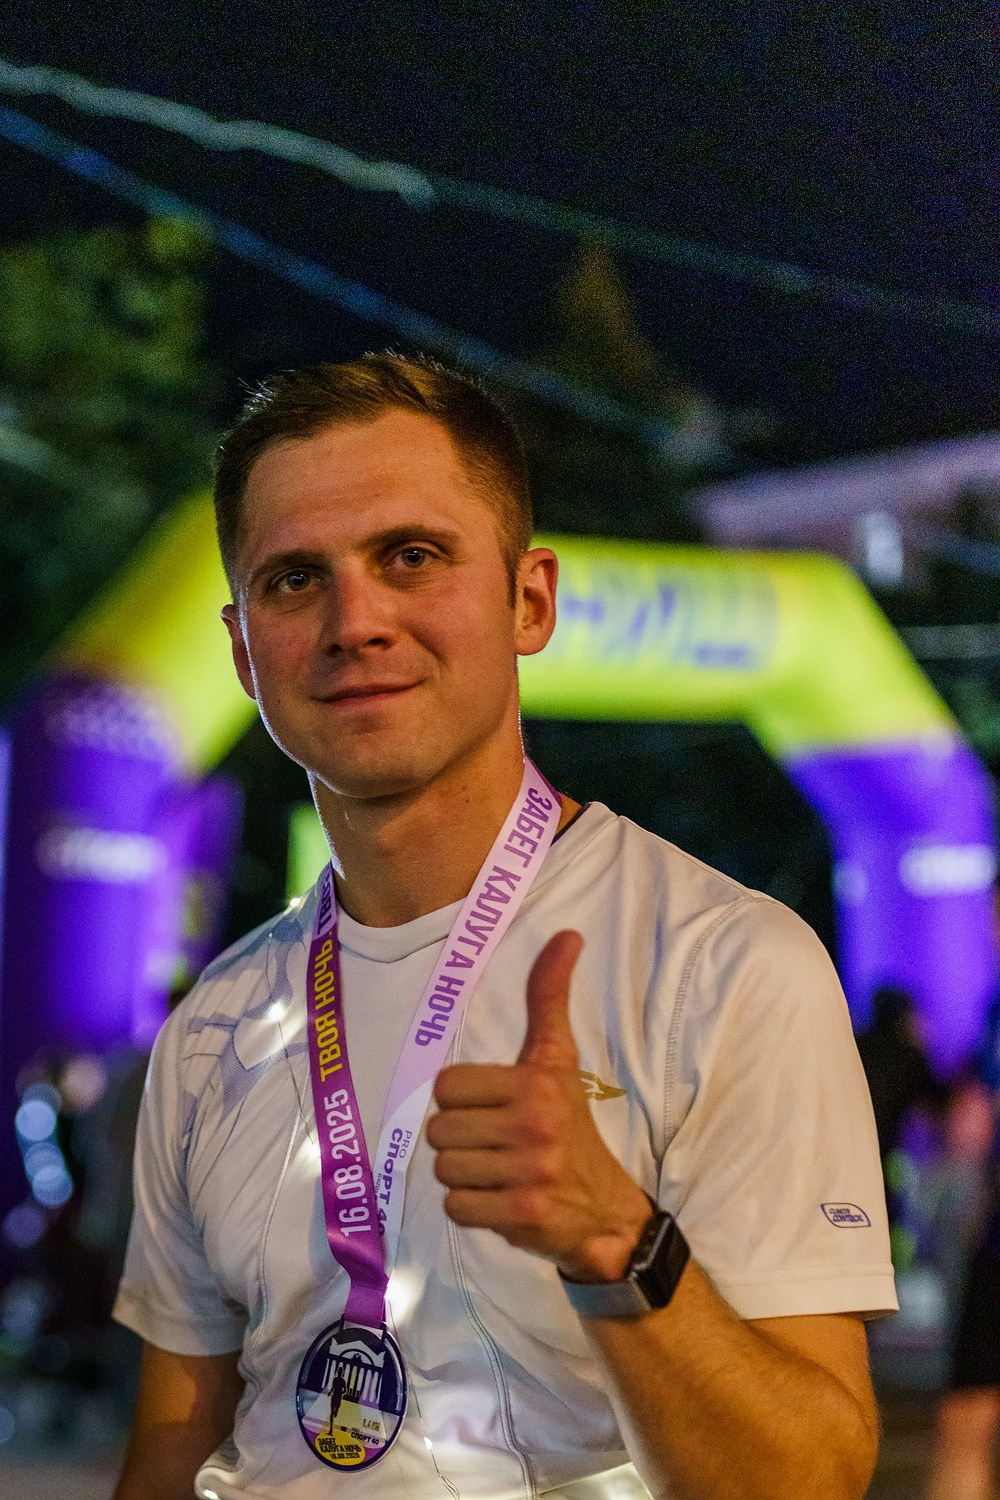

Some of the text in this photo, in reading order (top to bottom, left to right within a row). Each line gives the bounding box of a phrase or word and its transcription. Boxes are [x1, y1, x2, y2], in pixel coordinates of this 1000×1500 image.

[414, 787, 552, 1047] ЗАБЕГ КАЛУГА НОЧЬ
[315, 1009, 343, 1082] ТВОЯ
[323, 1088, 372, 1237] 16.08.2025
[379, 1128, 403, 1205] СПОРТ
[399, 1130, 412, 1158] PRO
[350, 1431, 371, 1443] СПОРТ
